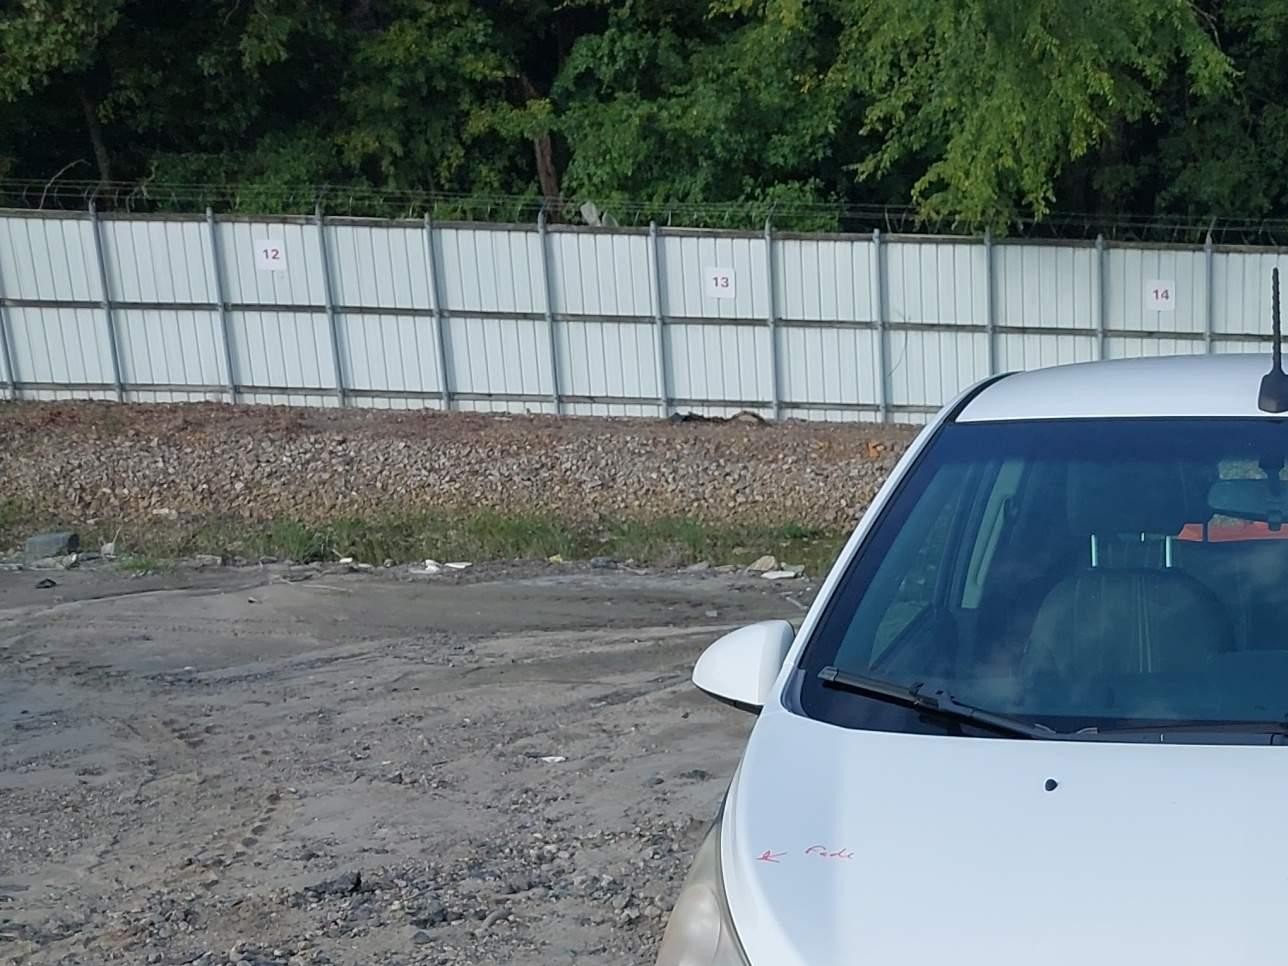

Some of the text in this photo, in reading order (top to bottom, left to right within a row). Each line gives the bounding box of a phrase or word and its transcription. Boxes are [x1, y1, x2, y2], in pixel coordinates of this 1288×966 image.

[263, 249, 280, 260] 12
[712, 276, 729, 288] 13
[1152, 289, 1169, 300] 14
